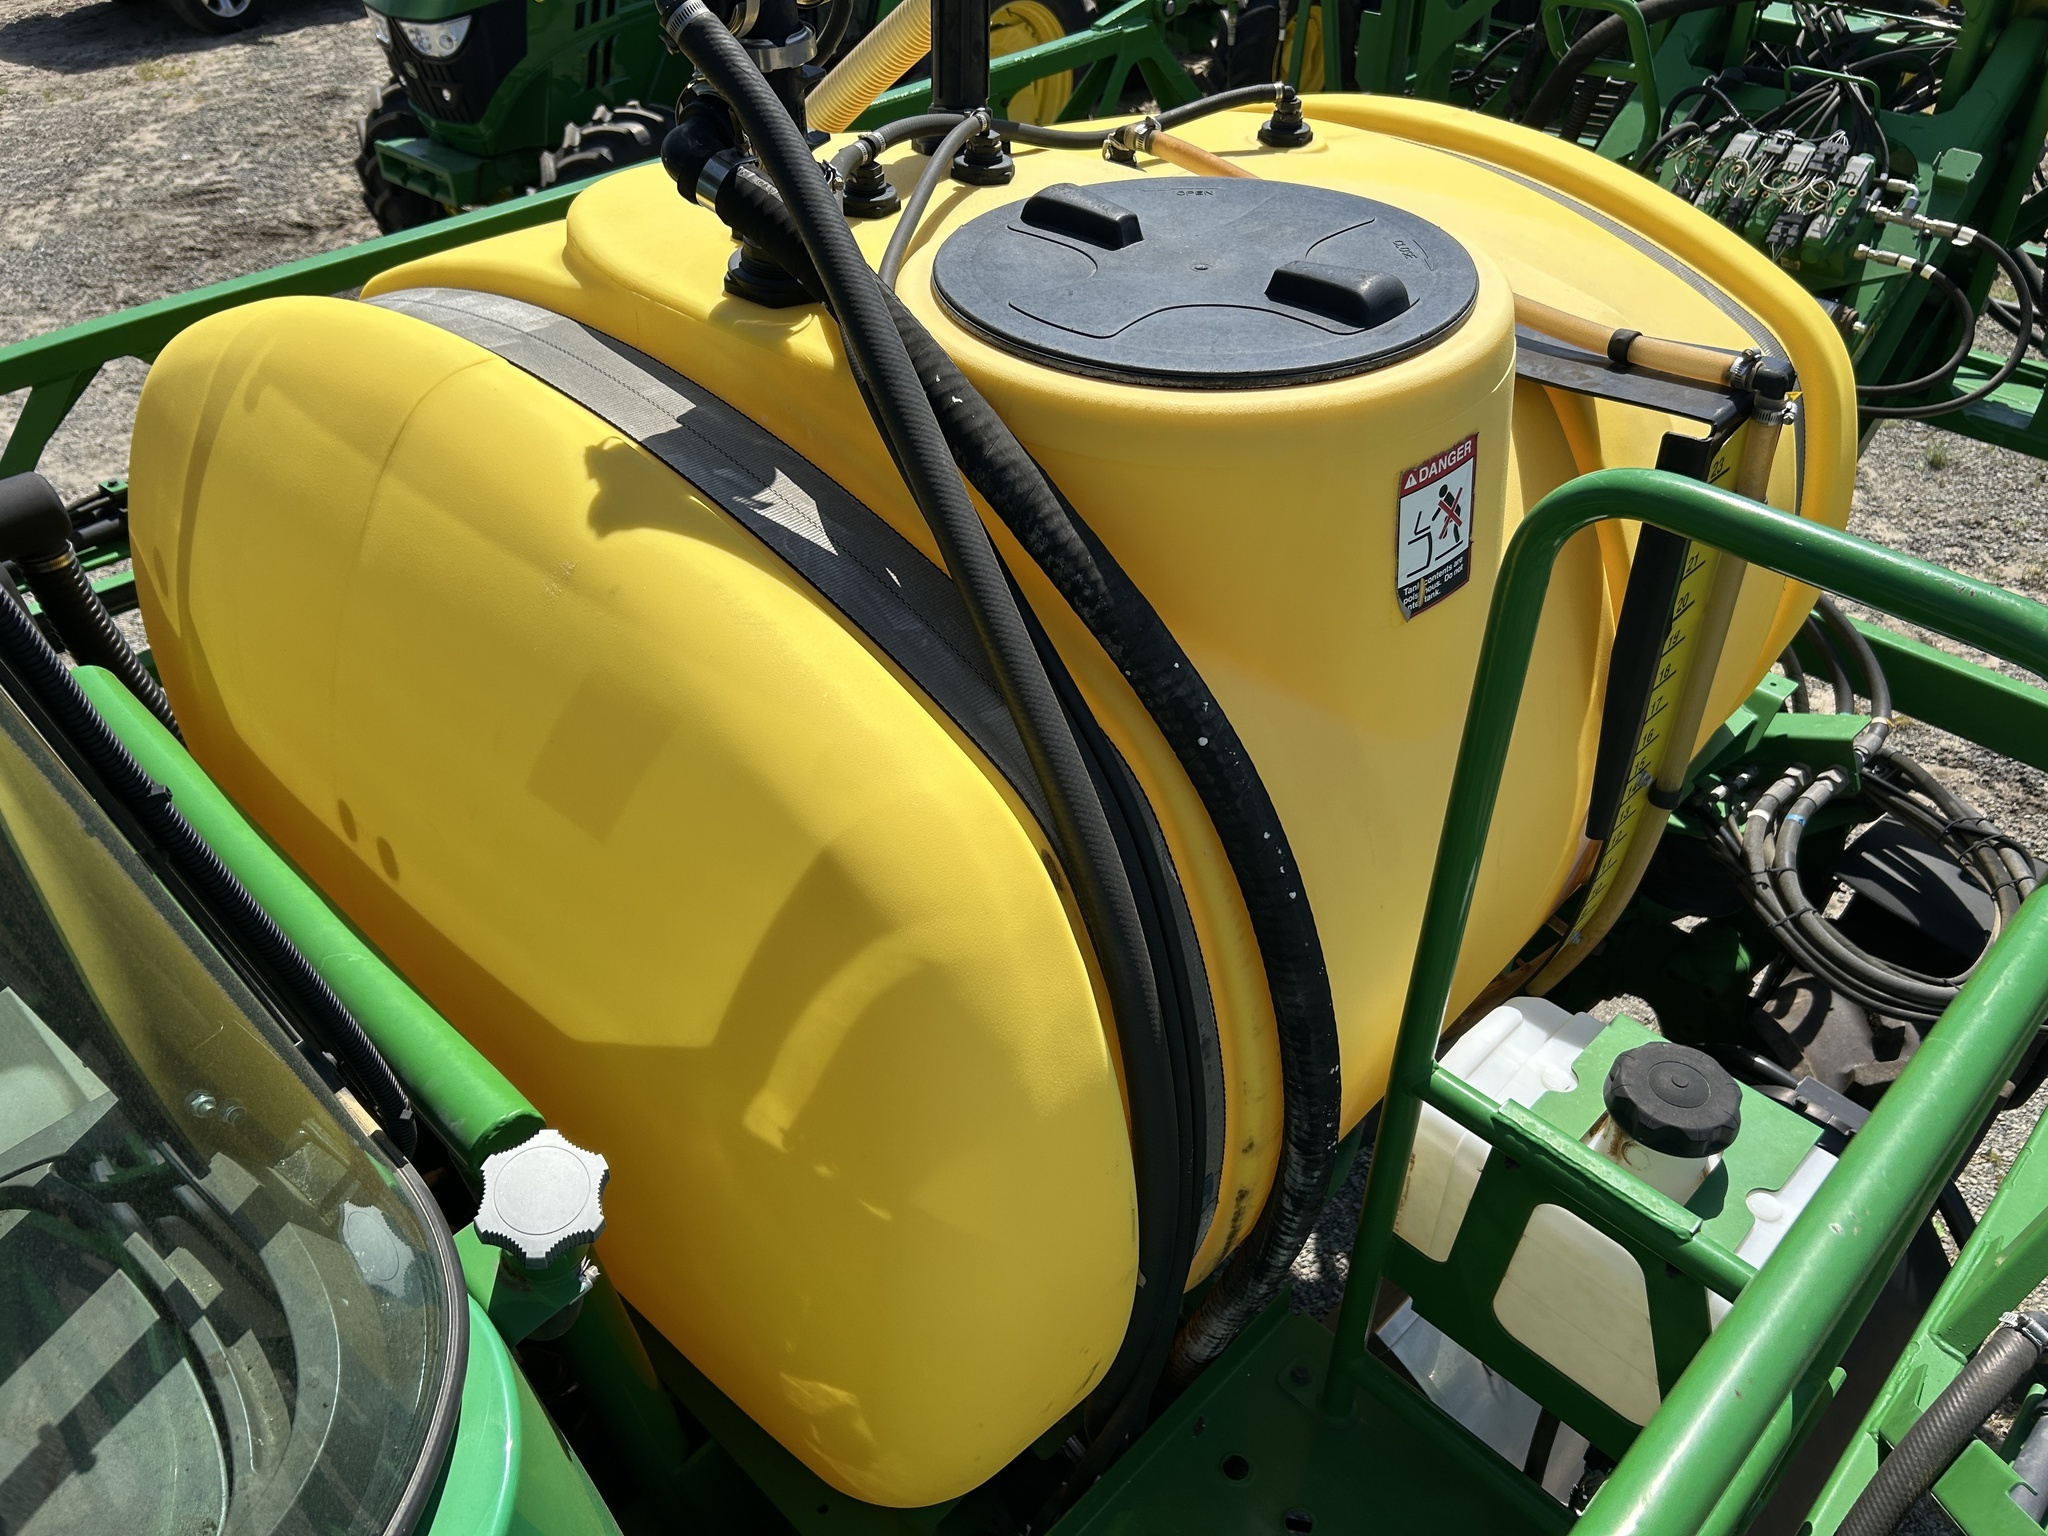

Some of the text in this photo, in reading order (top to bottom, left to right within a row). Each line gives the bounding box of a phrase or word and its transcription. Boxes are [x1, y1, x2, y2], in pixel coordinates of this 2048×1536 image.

[1392, 240, 1419, 260] CLOSE
[1419, 439, 1472, 483] DANGER
[1711, 457, 1725, 478] 23
[1424, 563, 1453, 586] contents
[1453, 556, 1464, 568] are
[1687, 552, 1700, 573] 21
[1403, 563, 1464, 605] poisnous. Do not
[1424, 588, 1442, 603] tank.
[1676, 592, 1690, 614] 20
[1668, 630, 1681, 649] 19
[1660, 663, 1672, 682] 18
[1651, 696, 1664, 714] 17
[1641, 728, 1654, 747] 16
[1634, 756, 1647, 775] 15
[1619, 805, 1631, 823] 13
[1611, 830, 1623, 846] 12
[1601, 857, 1613, 873] 11
